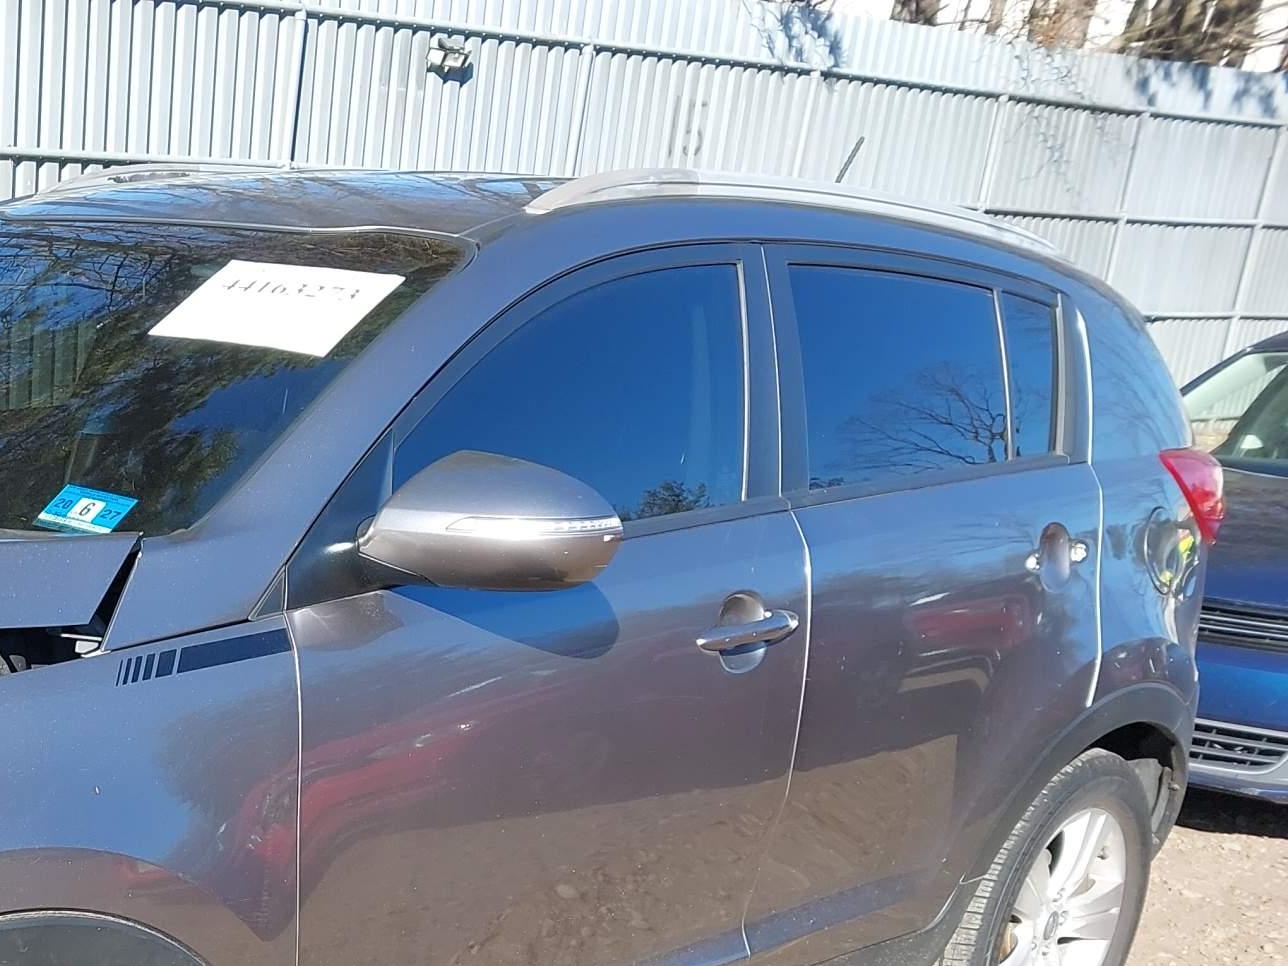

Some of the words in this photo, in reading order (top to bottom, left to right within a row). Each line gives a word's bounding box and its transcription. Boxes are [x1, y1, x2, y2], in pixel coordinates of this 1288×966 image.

[54, 498, 73, 510] 20
[78, 502, 96, 517] 6
[99, 508, 122, 520] 27
